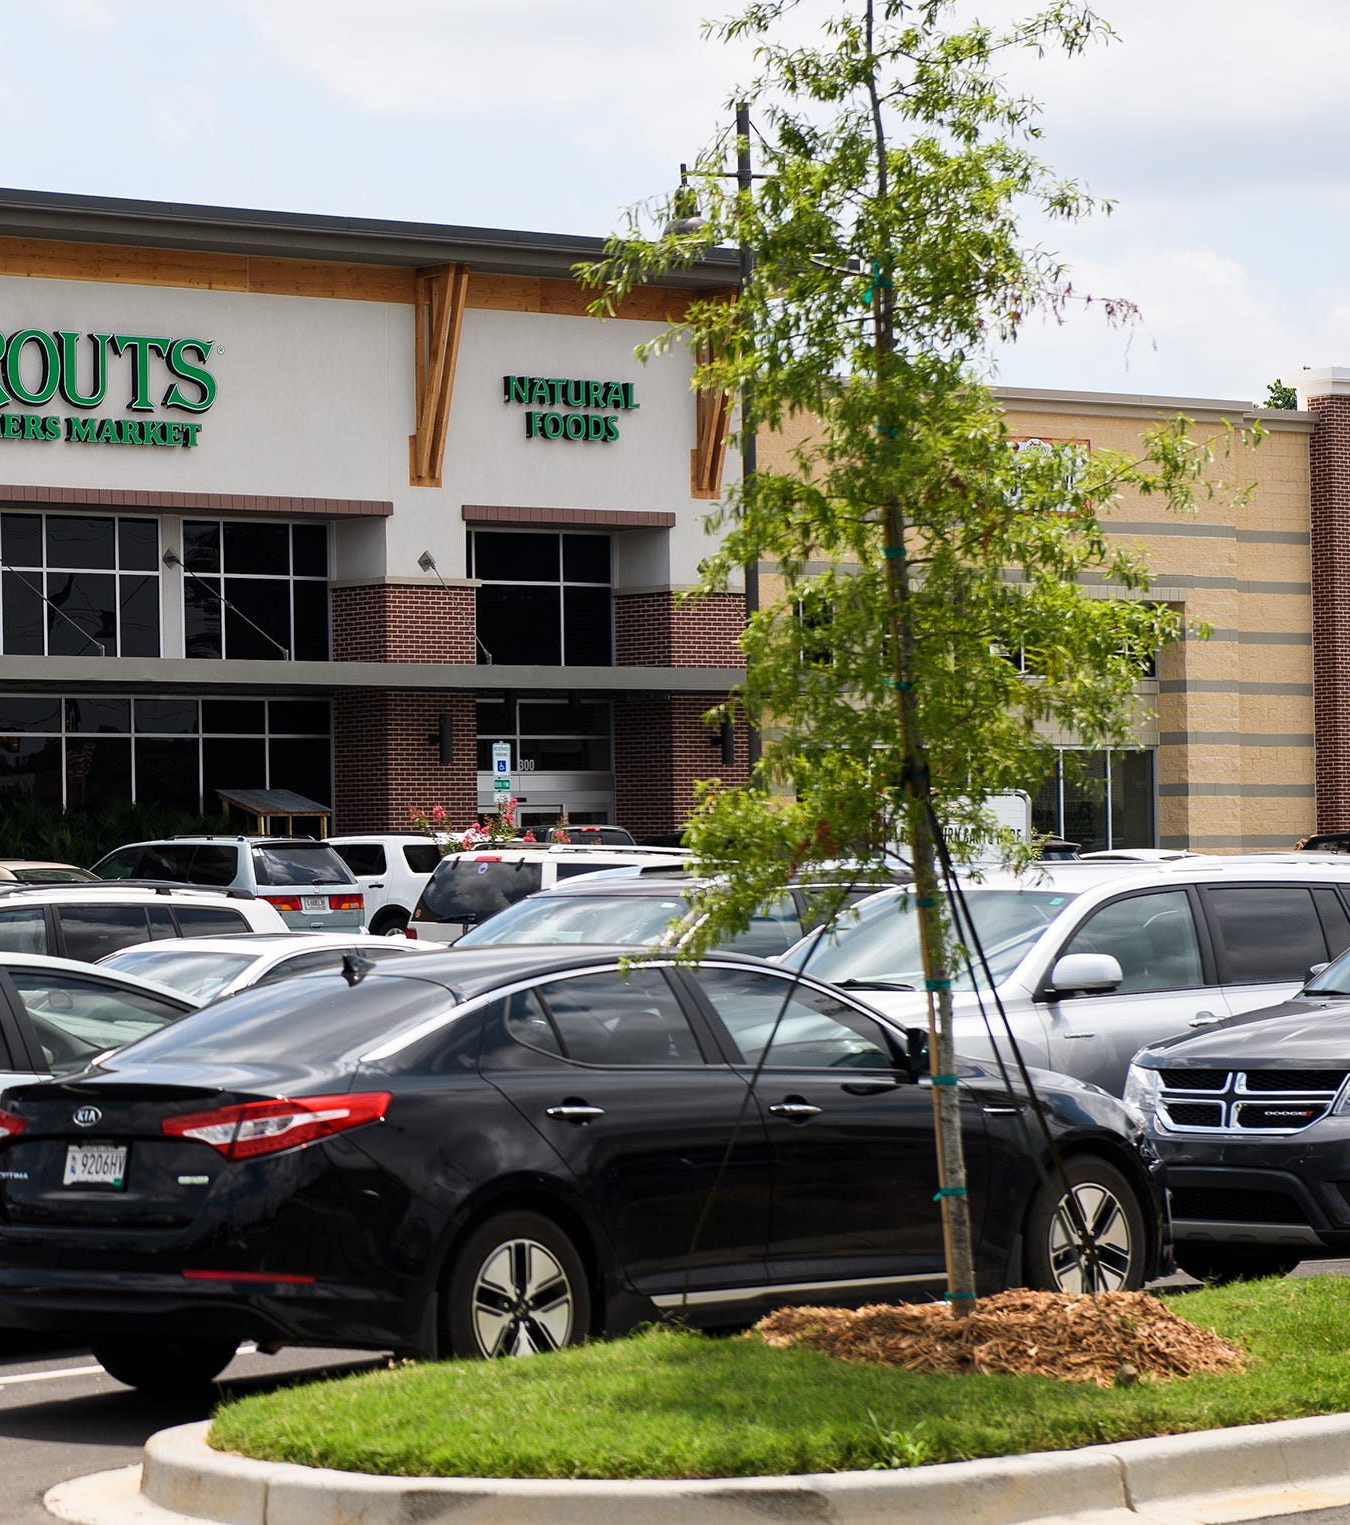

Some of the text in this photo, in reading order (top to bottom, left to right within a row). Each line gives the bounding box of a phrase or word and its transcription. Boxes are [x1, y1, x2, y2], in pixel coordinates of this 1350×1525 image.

[503, 376, 640, 409] NATURAL
[65, 417, 202, 448] MARKET
[526, 411, 619, 442] FOODS
[519, 760, 534, 770] 300
[77, 1109, 96, 1122] KIA
